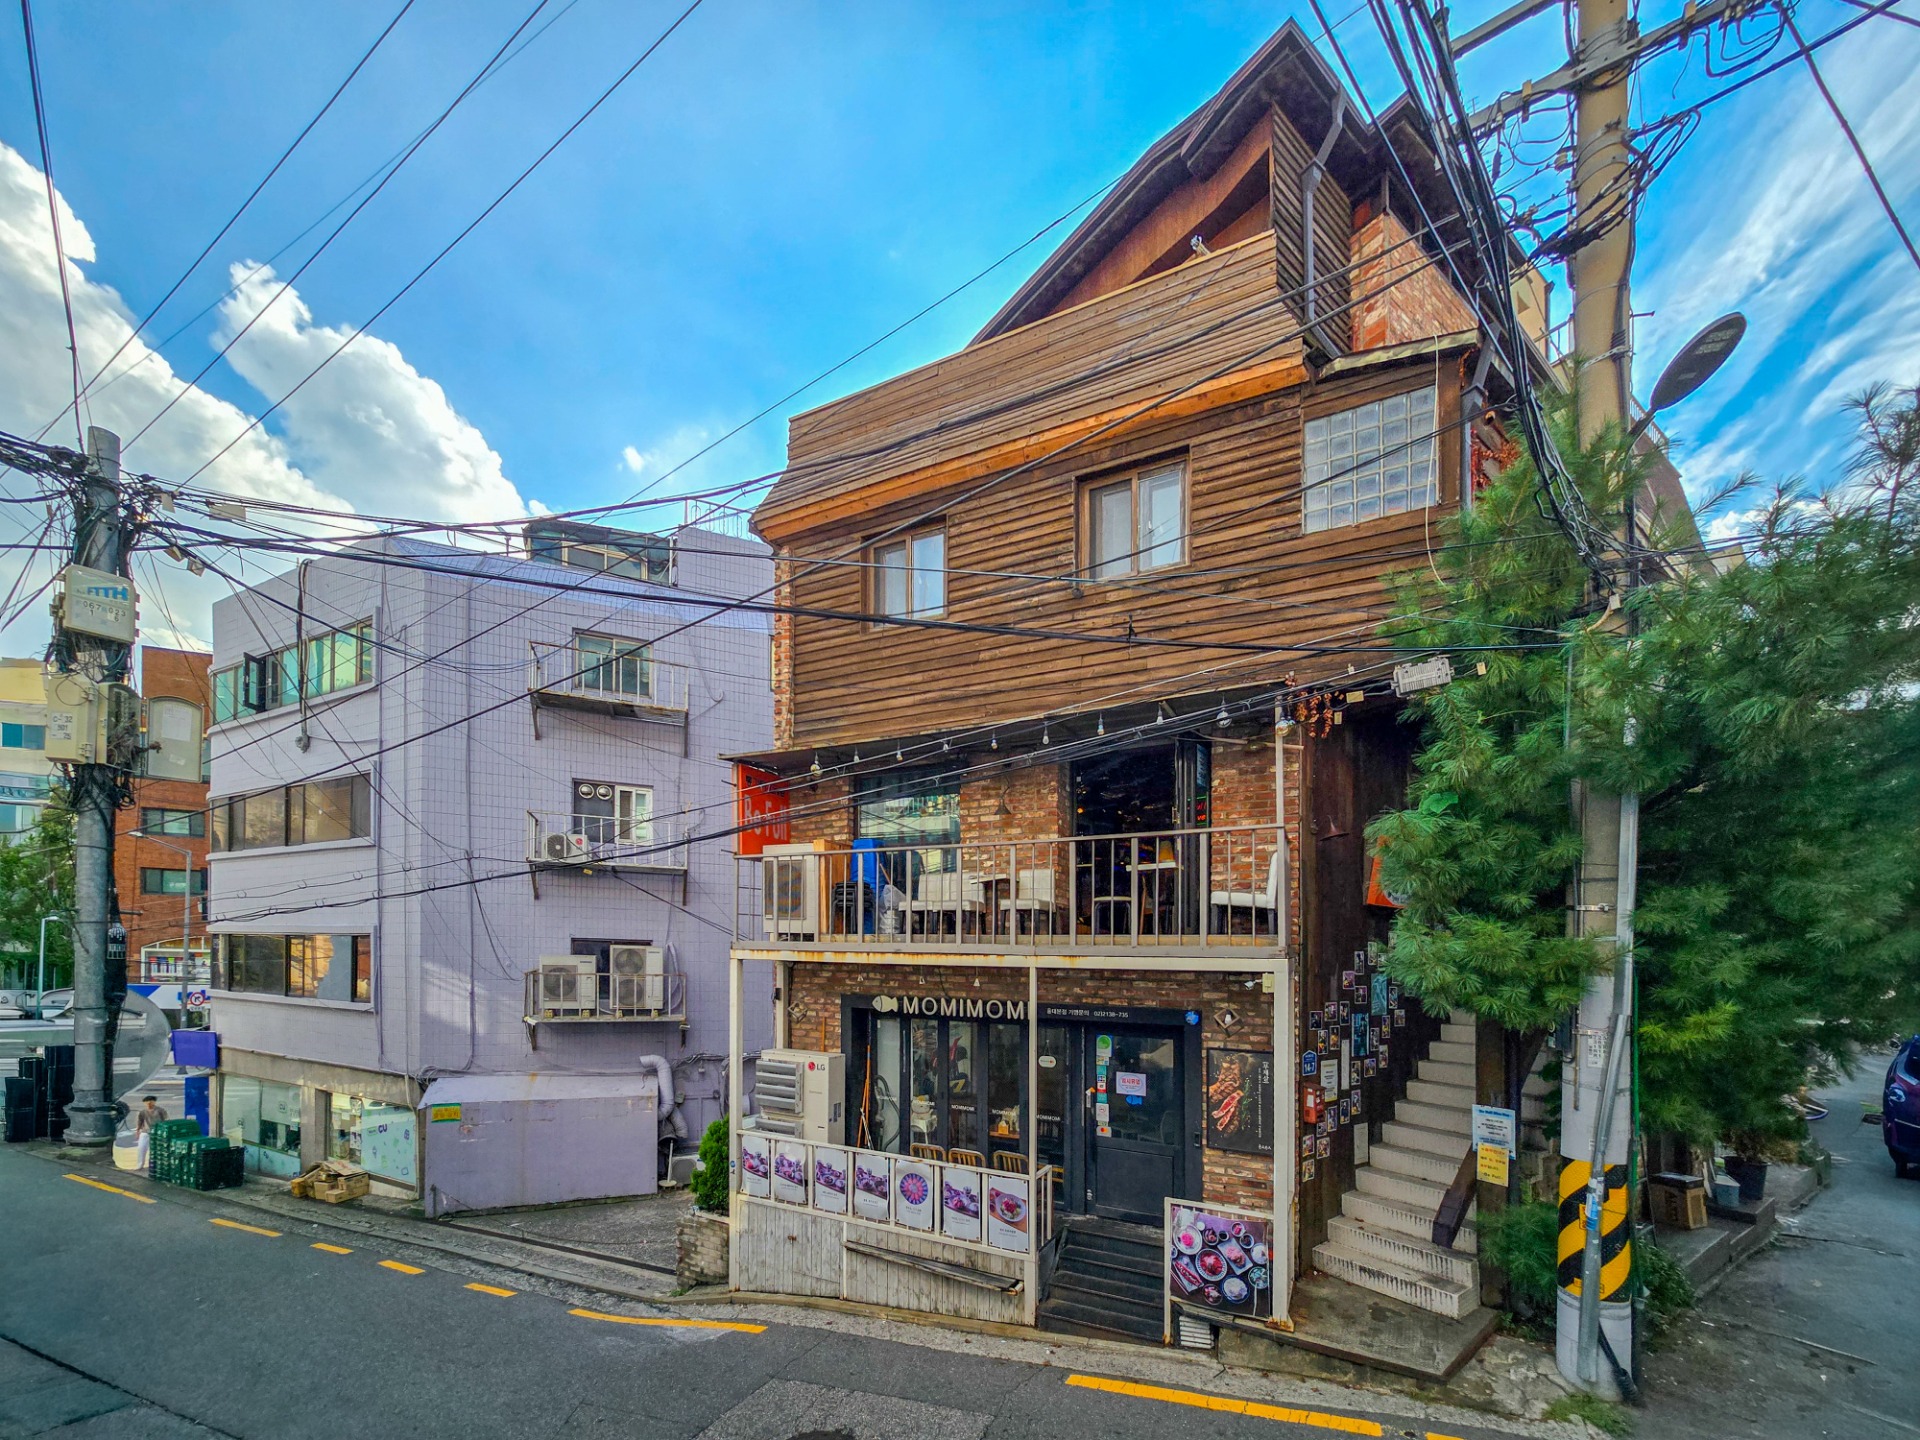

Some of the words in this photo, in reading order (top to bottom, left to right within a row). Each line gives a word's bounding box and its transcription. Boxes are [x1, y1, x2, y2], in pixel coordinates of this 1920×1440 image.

[87, 586, 128, 601] FTTH
[83, 601, 101, 611] 067
[108, 607, 126, 617] 023
[816, 1063, 826, 1071] LG
[1304, 1062, 1315, 1072] 14-7
[378, 1123, 388, 1134] CU
